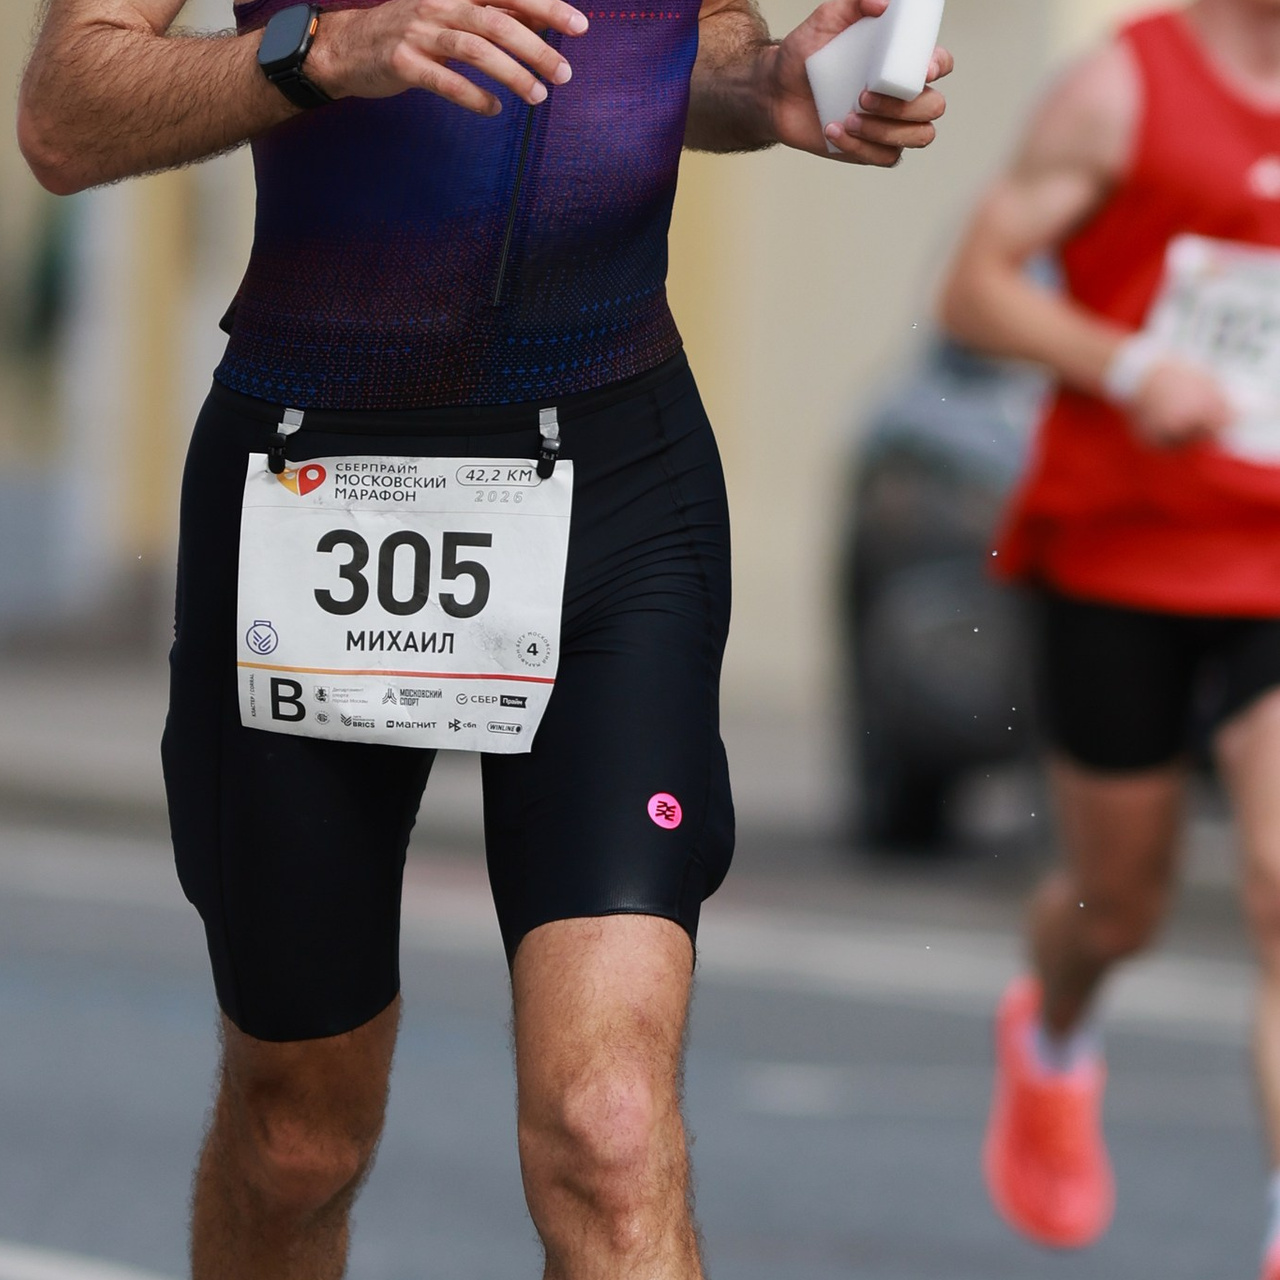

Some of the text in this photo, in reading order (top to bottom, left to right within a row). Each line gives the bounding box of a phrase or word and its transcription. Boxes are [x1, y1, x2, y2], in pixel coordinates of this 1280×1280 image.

[335, 463, 418, 474] СБЕРПРАЙМ
[335, 473, 447, 489] МОСКОВСКИЙ
[465, 469, 501, 483] 42,2
[334, 487, 417, 502] МАРАФОН
[474, 490, 524, 504] 2026
[314, 528, 493, 619] 305
[345, 630, 455, 654] МИХАИЛ
[526, 642, 539, 656] 4
[270, 677, 307, 723] B
[399, 688, 442, 699] МОСКОВСКИЙ
[470, 695, 498, 704] СБЕР
[399, 697, 419, 707] СПОРТ
[489, 722, 516, 732] WINLINE
